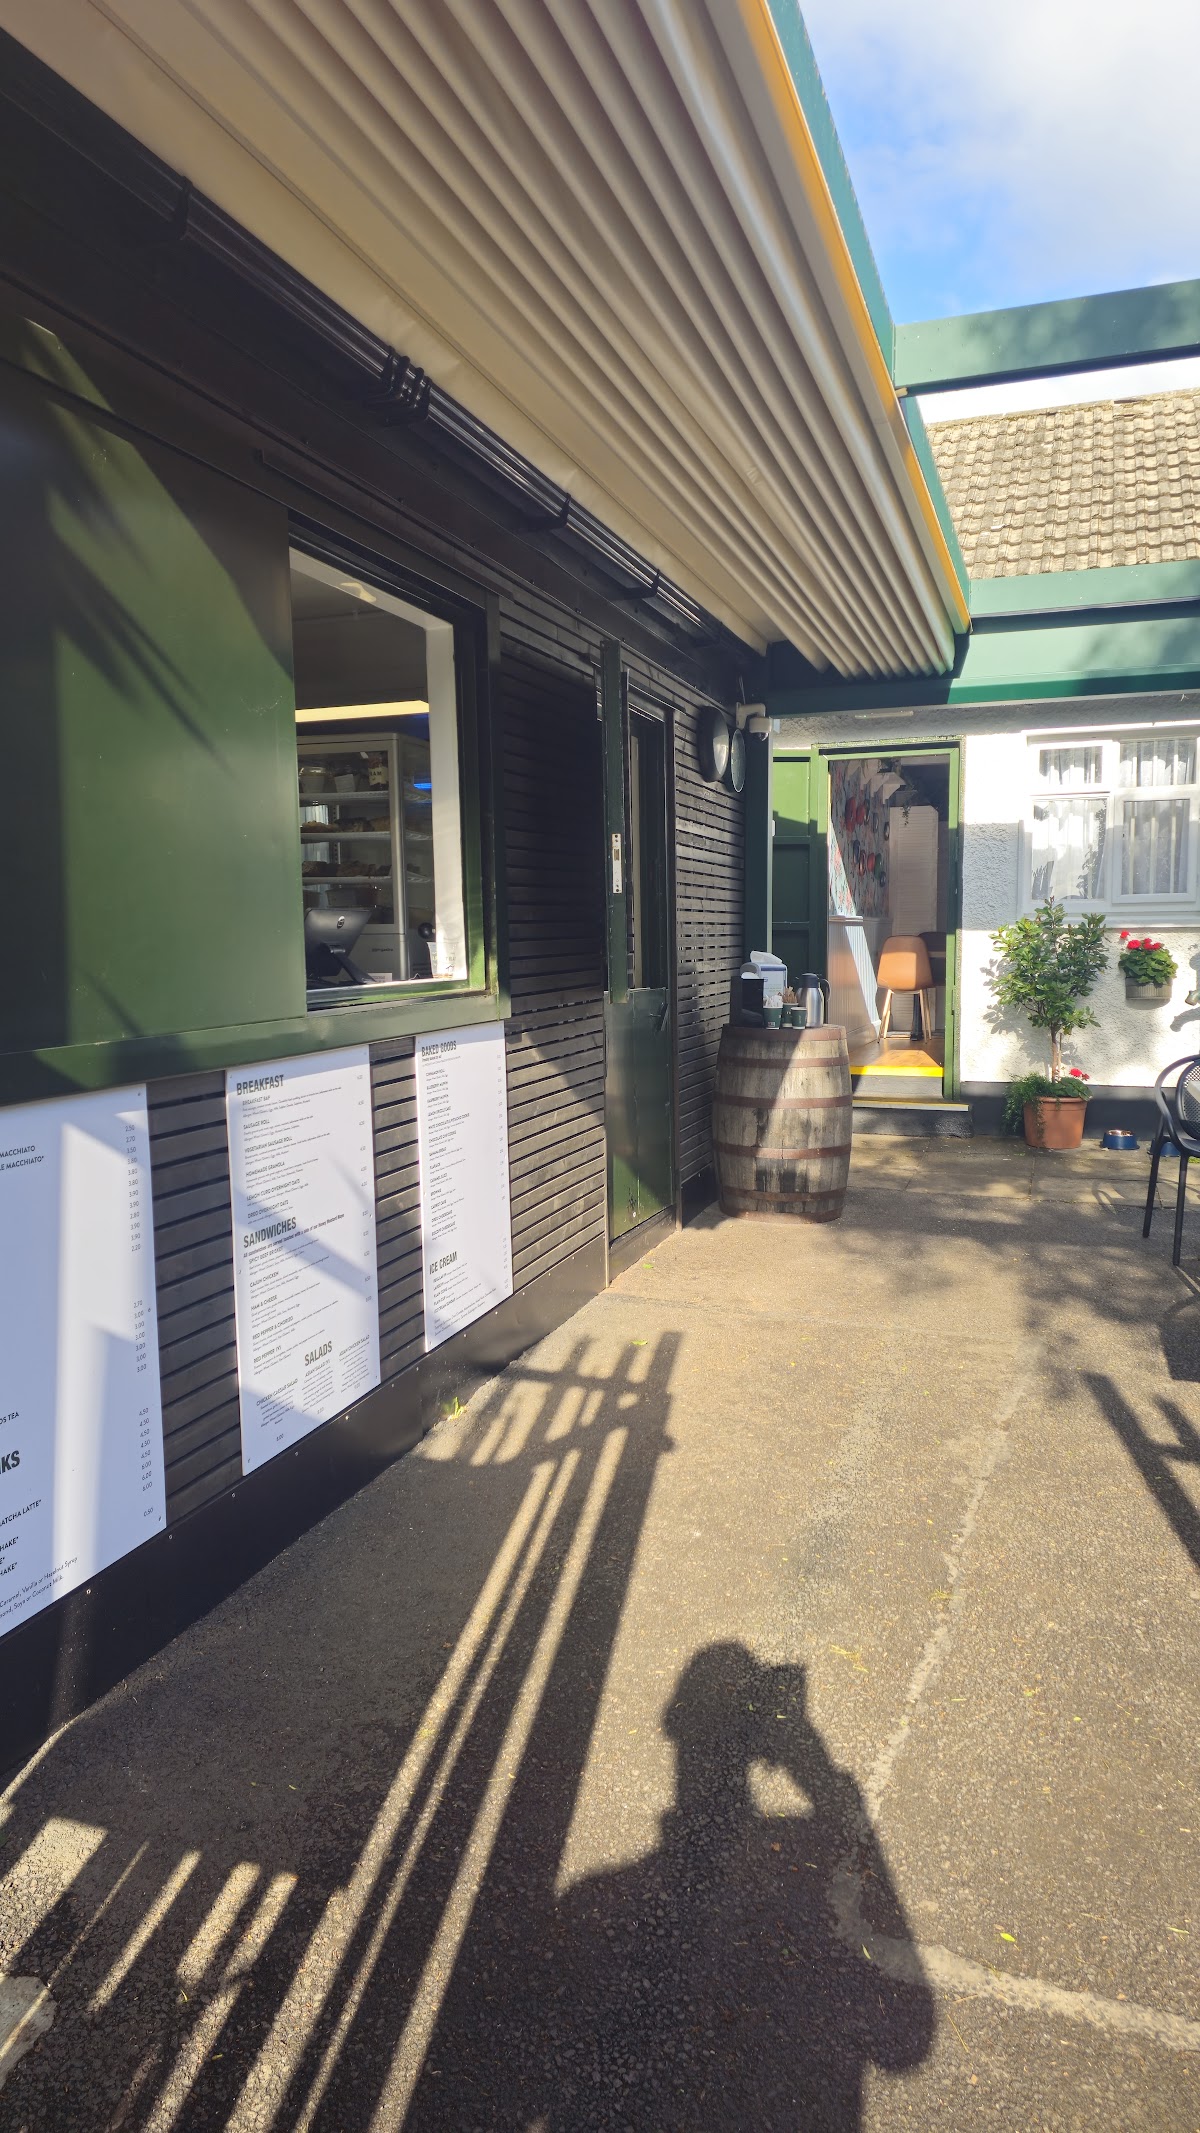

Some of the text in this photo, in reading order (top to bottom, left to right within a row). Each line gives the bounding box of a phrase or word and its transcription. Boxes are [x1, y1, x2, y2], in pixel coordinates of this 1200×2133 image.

[422, 1041, 456, 1056] BAKED GOODS
[237, 1074, 284, 1096] BREAKFAST
[244, 1217, 297, 1249] SANDWICHES
[430, 1251, 458, 1275] ICE CREAM
[263, 1271, 279, 1282] CHICKEN
[251, 1303, 260, 1311] HAM
[264, 1295, 277, 1305] CHEESE
[136, 1332, 145, 1341] 3.00
[305, 1340, 332, 1367] SALADS
[8, 1411, 19, 1421] TEA
[0, 1449, 20, 1475] KS
